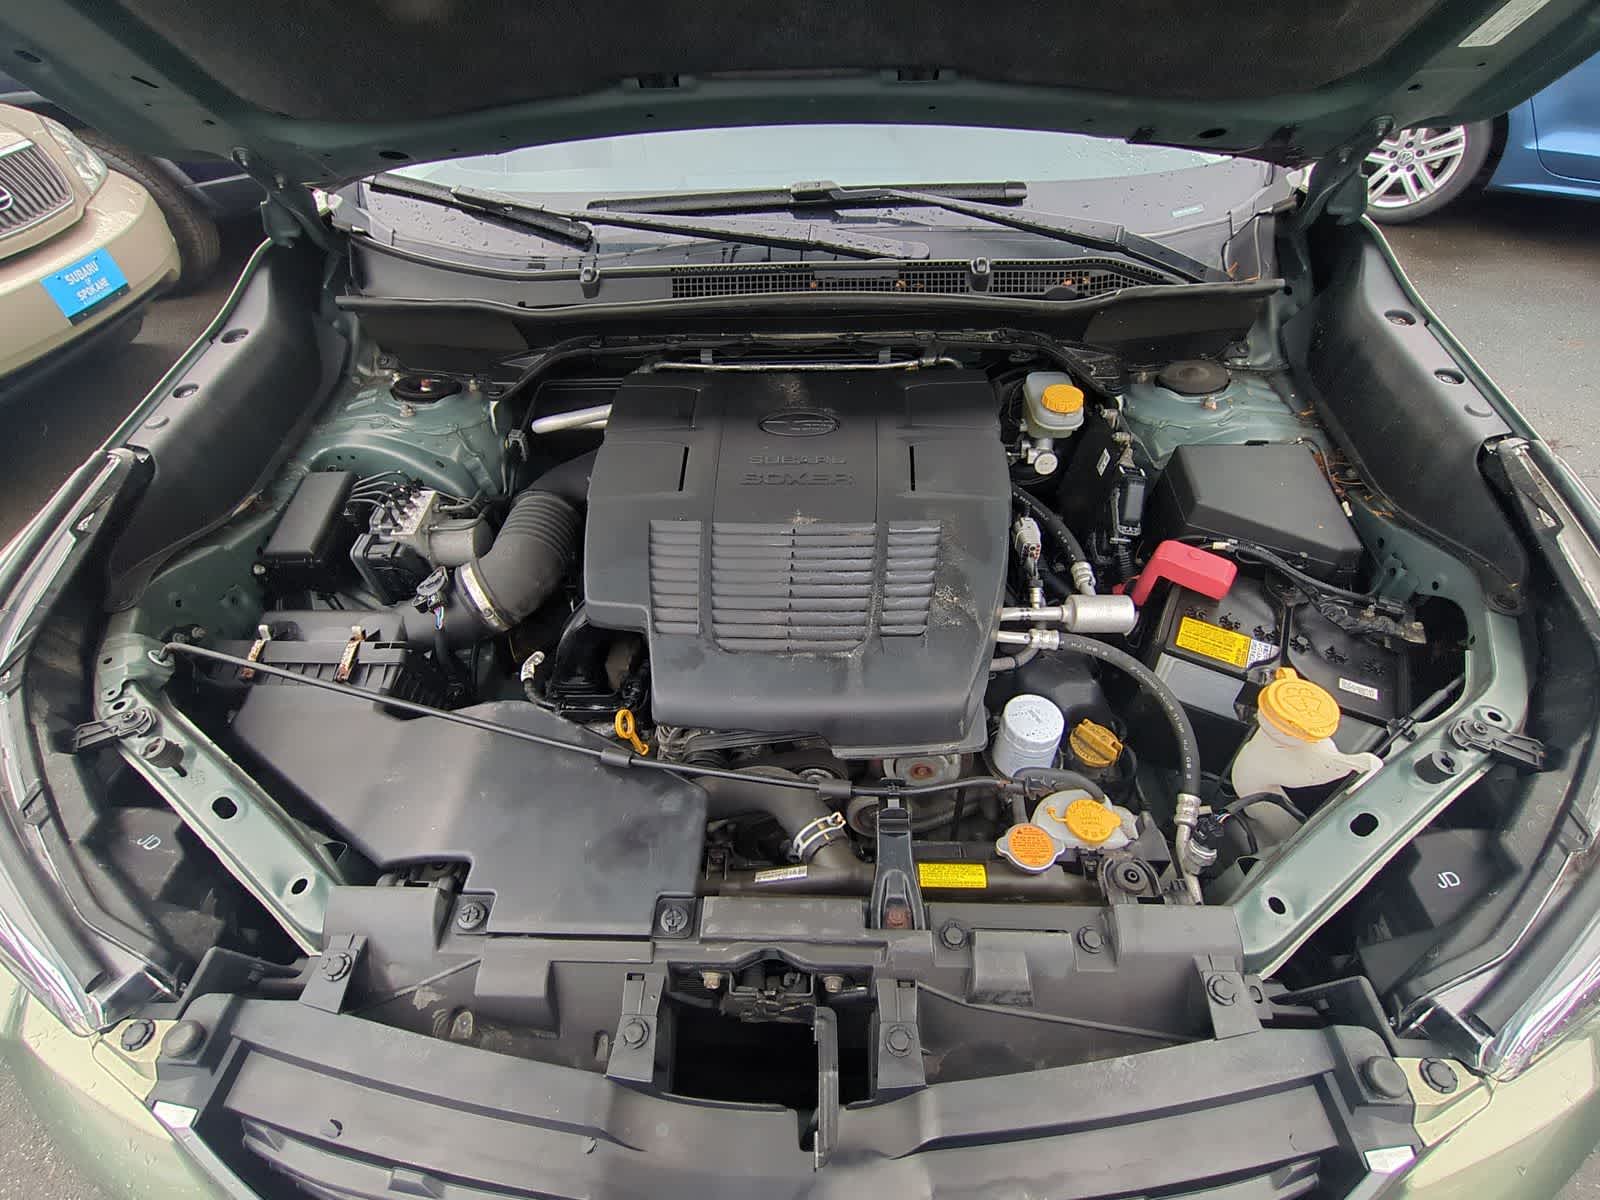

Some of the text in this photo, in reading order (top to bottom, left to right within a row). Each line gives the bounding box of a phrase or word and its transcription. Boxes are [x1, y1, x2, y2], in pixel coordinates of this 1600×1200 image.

[65, 261, 99, 285] SUBARU
[76, 277, 110, 300] SPOKANE
[750, 455, 848, 465] SUBARU
[740, 473, 856, 486] BOXER
[136, 834, 161, 850] JD
[1437, 871, 1461, 889] JD
